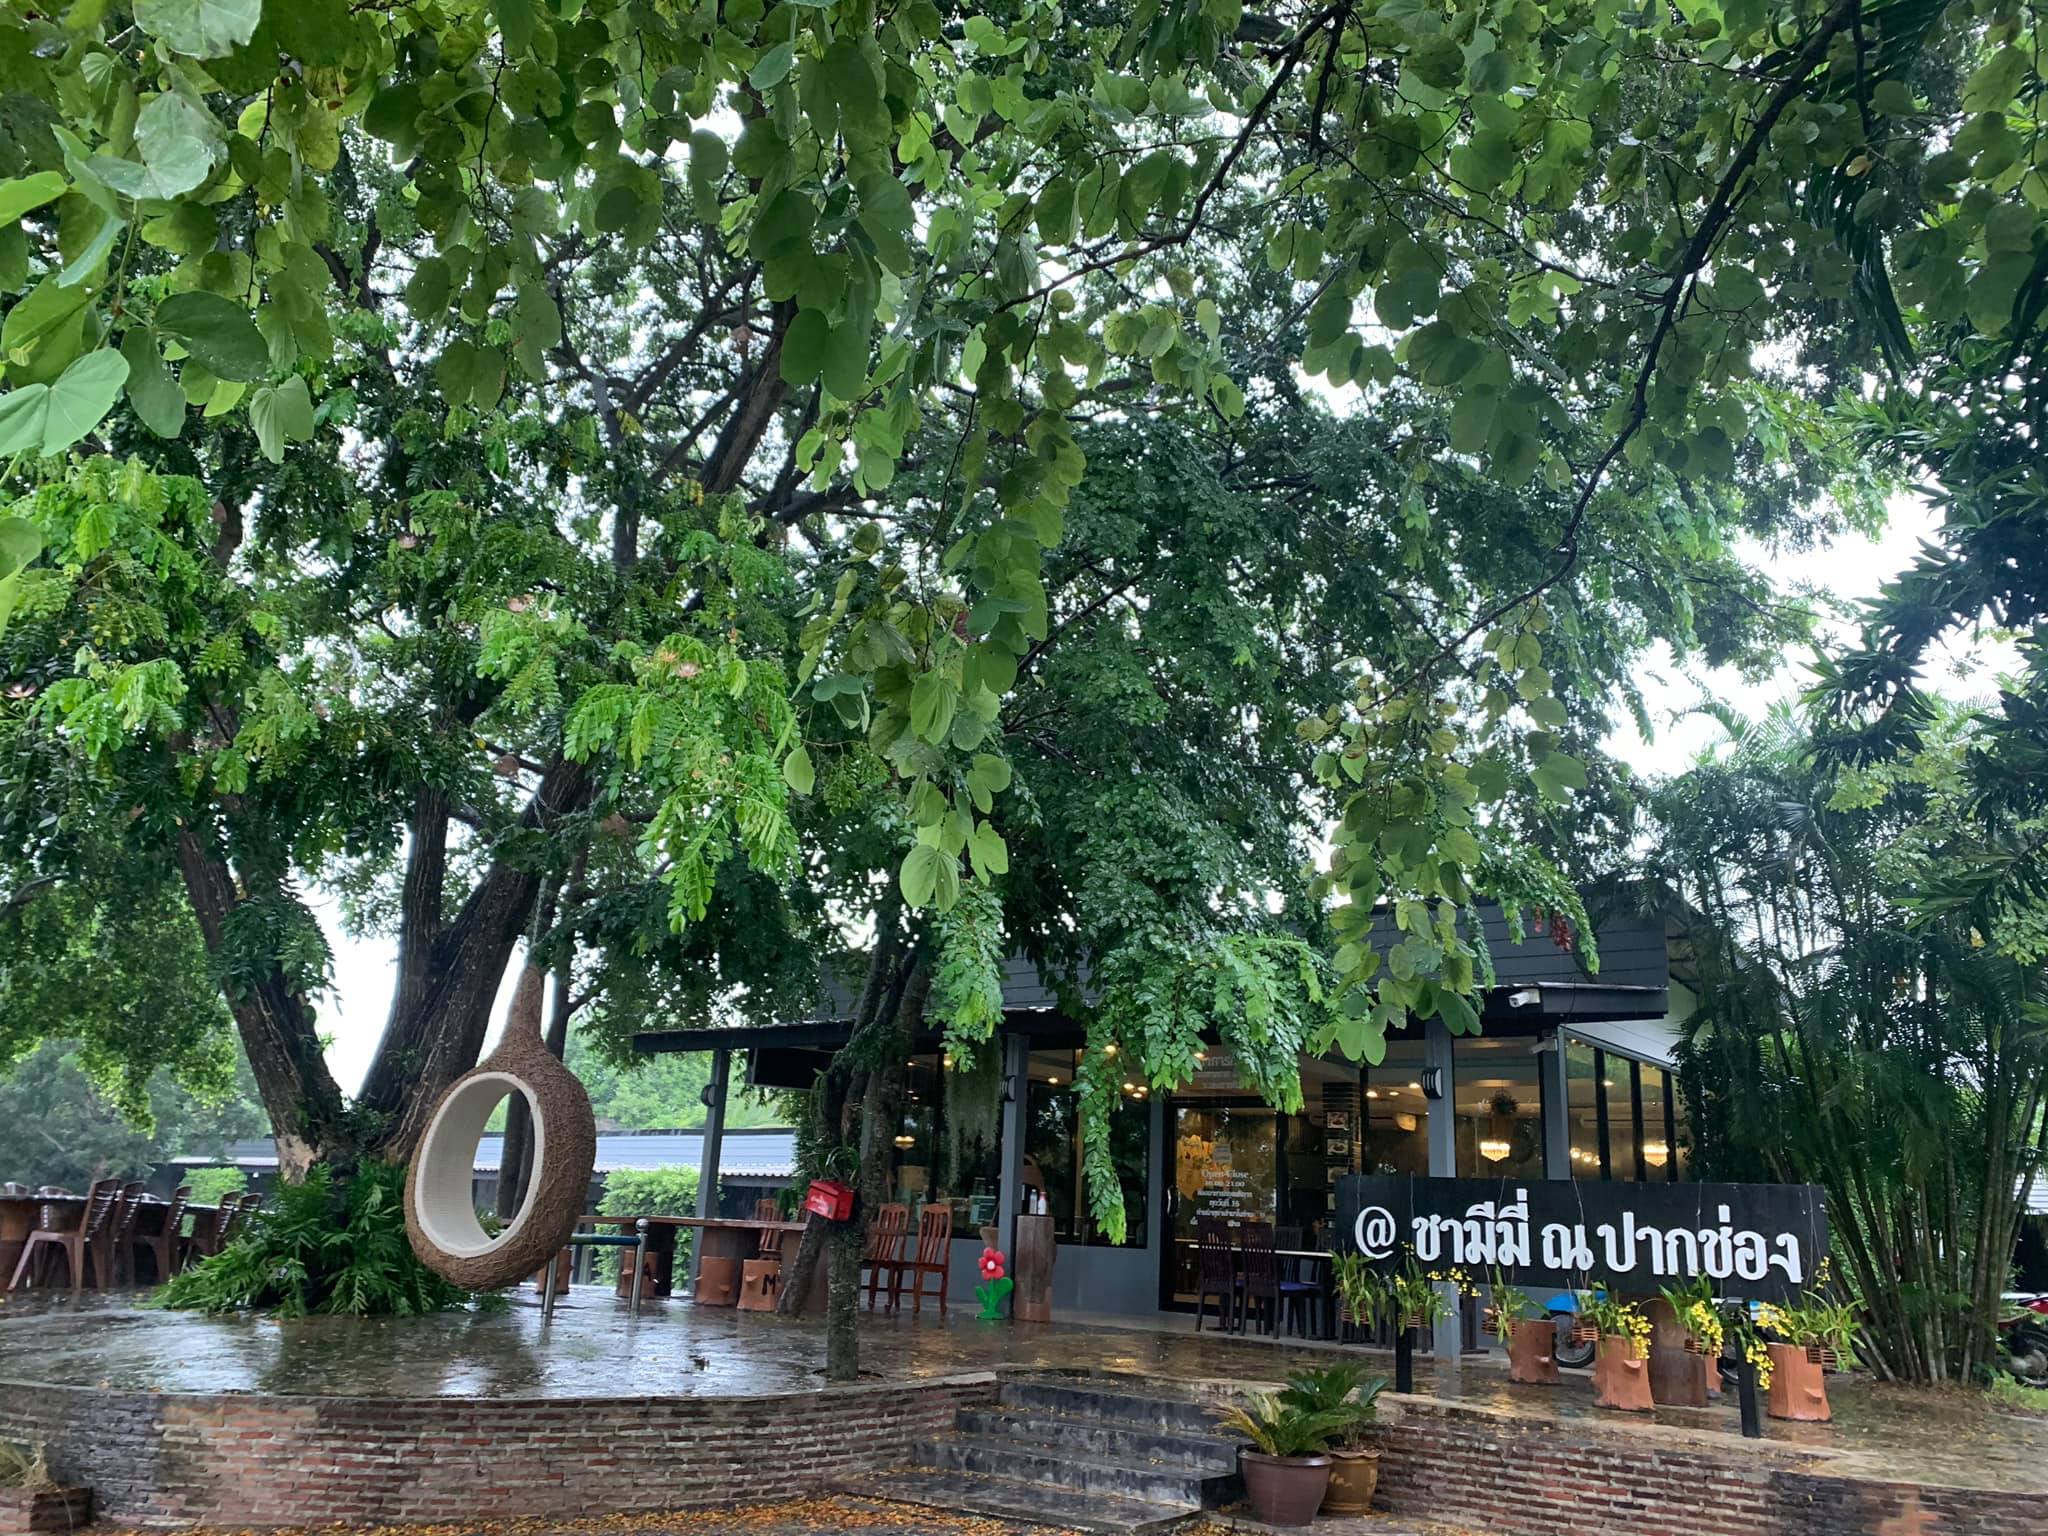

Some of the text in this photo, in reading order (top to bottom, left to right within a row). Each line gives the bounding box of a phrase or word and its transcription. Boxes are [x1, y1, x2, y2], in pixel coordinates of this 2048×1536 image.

[1354, 1188, 1804, 1284] @ ชามีมี่ ณ ปากช่อง
